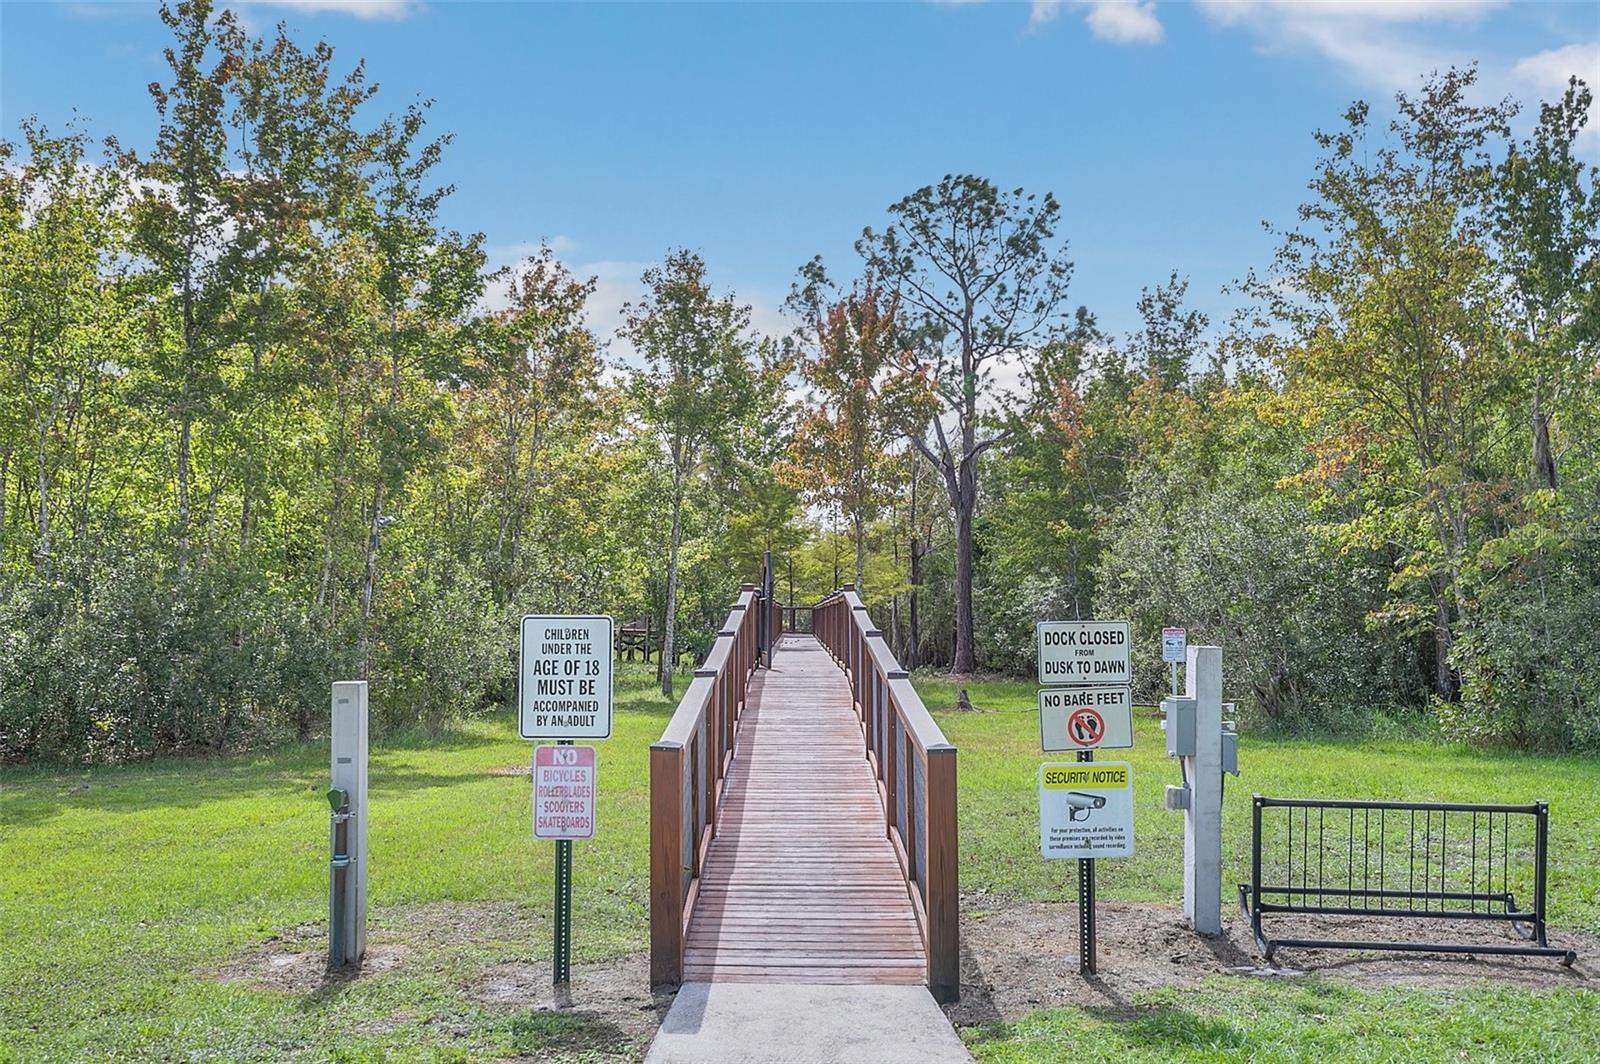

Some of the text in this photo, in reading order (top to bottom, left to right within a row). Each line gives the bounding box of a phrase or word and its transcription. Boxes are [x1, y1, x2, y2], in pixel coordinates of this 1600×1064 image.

[544, 628, 589, 640] CHILDREN
[1045, 630, 1125, 646] DOCK CLOSED
[542, 643, 592, 655] UNDER THE
[1075, 649, 1095, 657] FROM
[533, 660, 600, 676] AGE OF 18
[1045, 660, 1125, 674] DUSK TO DAWN
[537, 679, 595, 696] MUST BE
[1044, 692, 1124, 707] NO BARE FEET
[533, 700, 599, 712] ACCOMPANIED
[536, 715, 596, 727] BY AN ADULT
[552, 749, 578, 765] NO
[543, 770, 586, 782] BICYCLES
[1045, 770, 1126, 784] SECURITY NOTICE
[538, 785, 591, 798] ROLLERBLADES
[544, 801, 585, 813] SCOOTERS
[538, 816, 590, 828] SKATEBOARDS
